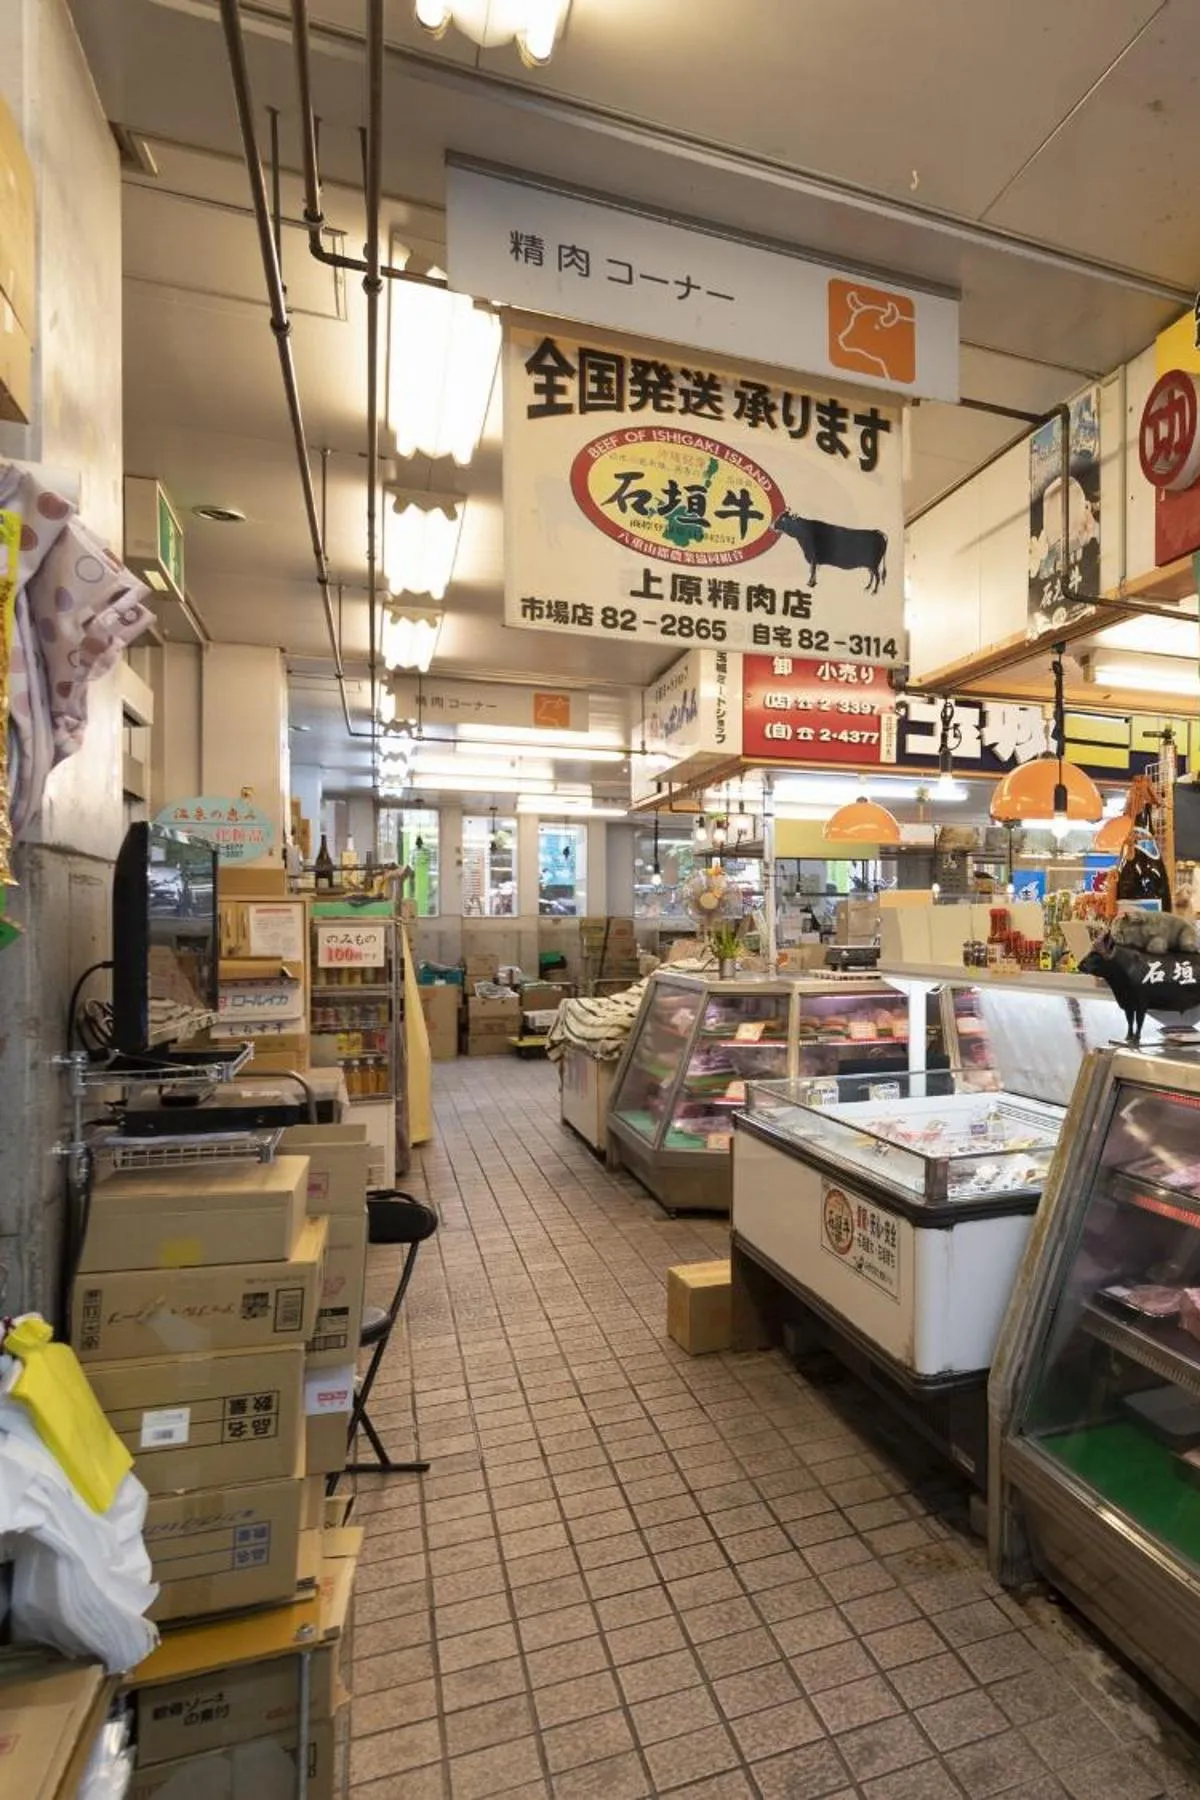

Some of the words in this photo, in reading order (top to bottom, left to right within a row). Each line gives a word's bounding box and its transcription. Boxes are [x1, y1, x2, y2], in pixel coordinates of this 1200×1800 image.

[509, 230, 735, 302] 精肉コーナー
[588, 437, 618, 458] BEEF
[625, 430, 648, 442] OF
[653, 430, 720, 456] ISHIGAKI
[723, 450, 773, 491] ISLAND
[600, 472, 764, 540] 石垣牛
[630, 568, 812, 620] 上原精肉店
[521, 597, 595, 627] 市場店
[752, 623, 793, 649] 自宅
[816, 662, 875, 684] 小売り
[326, 932, 377, 946] のみもの
